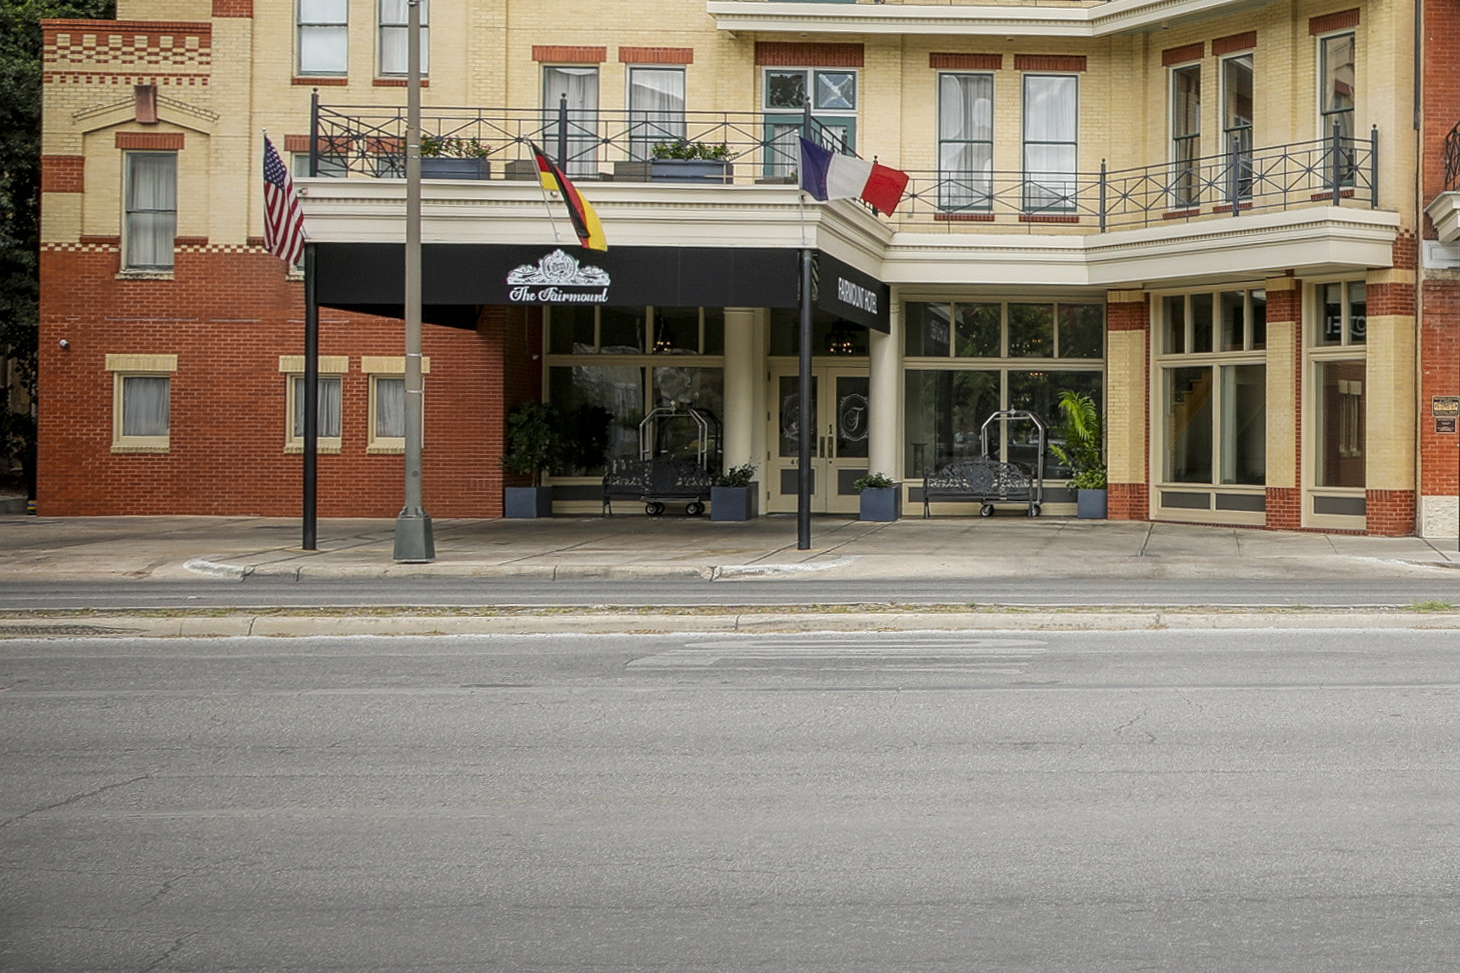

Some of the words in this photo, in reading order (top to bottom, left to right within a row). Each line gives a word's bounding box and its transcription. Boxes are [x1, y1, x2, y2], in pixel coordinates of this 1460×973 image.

[509, 286, 537, 302] The
[538, 286, 609, 303] Fairmount
[864, 289, 878, 315] HOTEL
